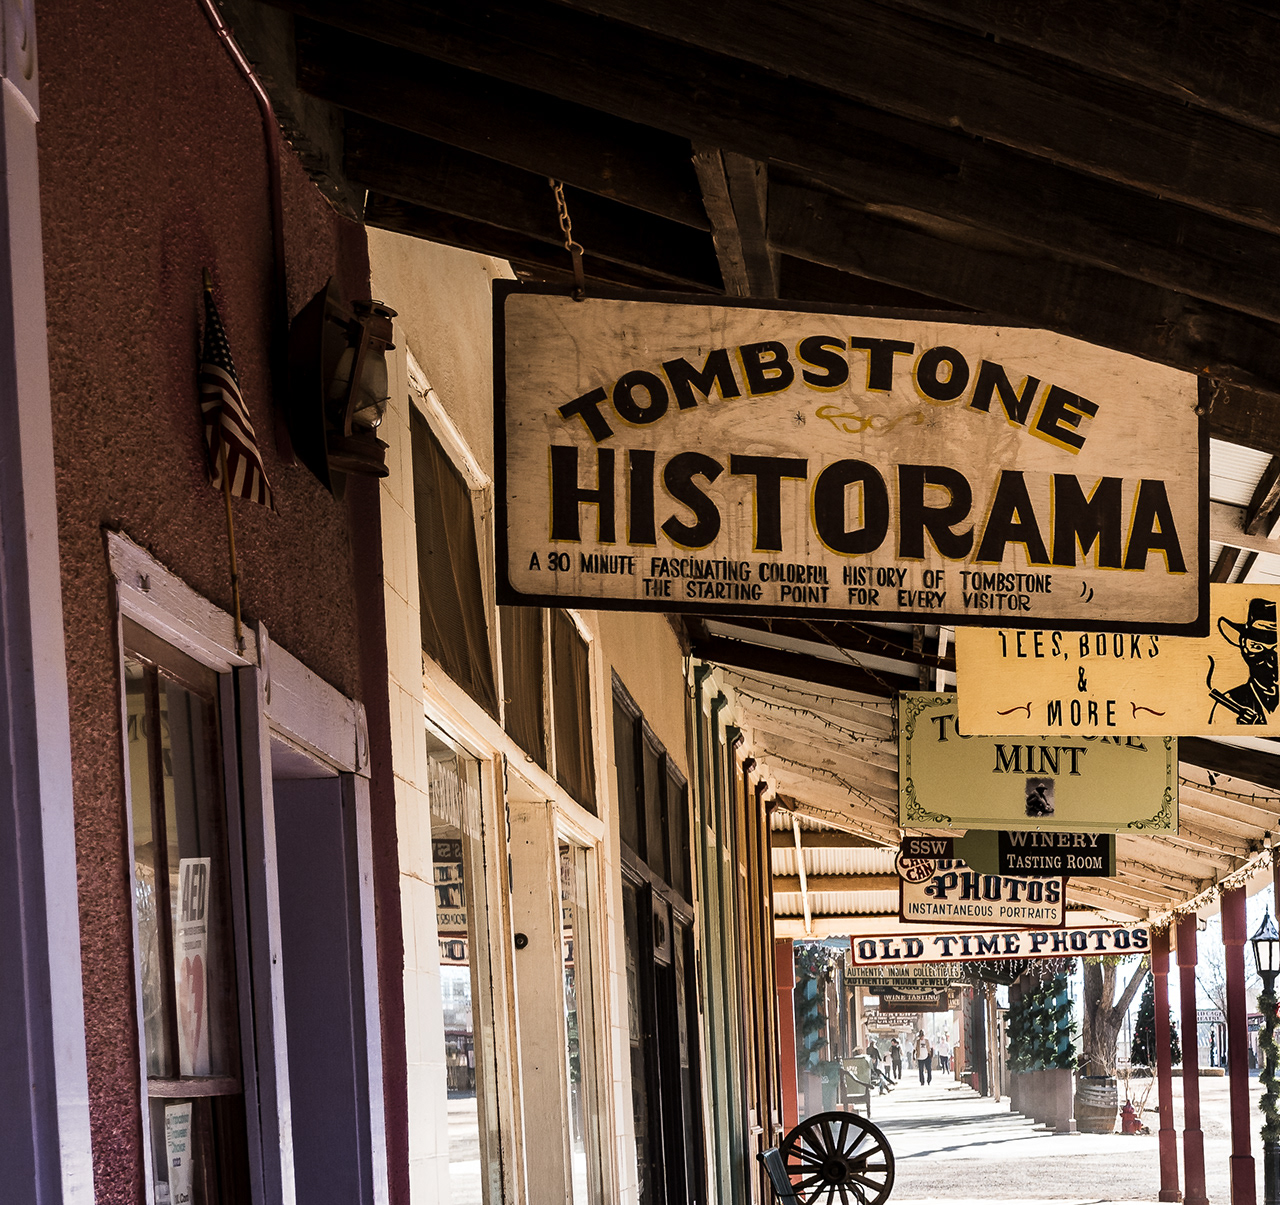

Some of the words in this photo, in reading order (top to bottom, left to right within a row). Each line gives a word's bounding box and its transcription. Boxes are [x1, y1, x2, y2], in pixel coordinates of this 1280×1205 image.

[557, 334, 1100, 455] TOMBSTONE
[549, 442, 1189, 574] HISTORAMA
[529, 552, 542, 573] A
[547, 552, 572, 573] 30
[580, 554, 636, 576] MINUTE
[758, 562, 830, 585] COLORFUL
[842, 567, 906, 588] HISTORY
[923, 569, 946, 591] OF
[959, 570, 1053, 595] TOMBSTONE
[644, 577, 674, 601] THE
[686, 579, 763, 603] STARTING
[780, 583, 830, 606] POINT
[847, 587, 880, 607] FOR
[897, 588, 947, 610] EVERY
[962, 589, 1033, 613] VISITOR
[1079, 633, 1160, 661] BOOKS
[1077, 665, 1088, 693] &
[1047, 699, 1118, 728] MORE
[992, 743, 1088, 776] MINT
[909, 840, 948, 855] SSW
[1008, 831, 1099, 849] WINERY
[906, 862, 934, 881] CAN
[1007, 854, 1062, 869] TASTING
[1067, 855, 1103, 870] ROOM
[182, 863, 206, 921] AED
[924, 871, 1060, 904] PHOTOS
[908, 903, 994, 917] INSTANTANEOUS
[1000, 905, 1058, 919] PORTRAITS
[857, 938, 925, 960] OLD
[933, 934, 1021, 957] TIME
[1029, 928, 1149, 953] PHOTOS
